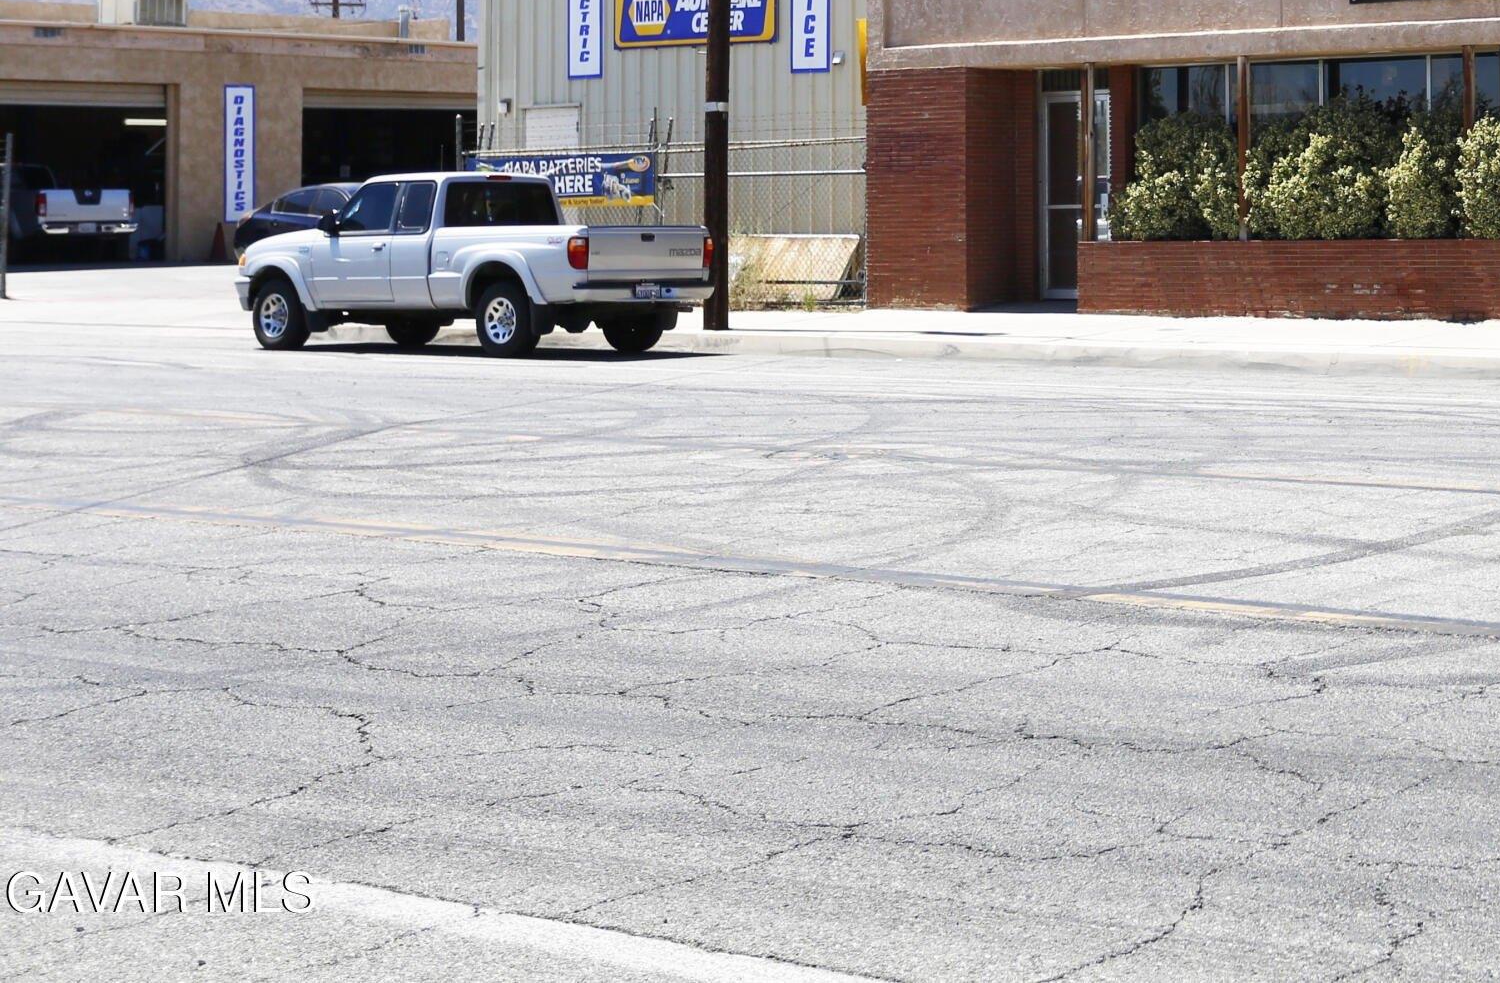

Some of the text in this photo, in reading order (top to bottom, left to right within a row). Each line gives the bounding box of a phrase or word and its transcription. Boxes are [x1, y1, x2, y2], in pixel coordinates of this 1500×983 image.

[635, 0, 664, 23] NAPA
[692, 10, 745, 34] CEER
[234, 95, 246, 212] DIAGNOSTICS
[504, 156, 602, 175] NAPA BATTERIES
[555, 174, 593, 194] HERE
[669, 248, 701, 256] mazda
